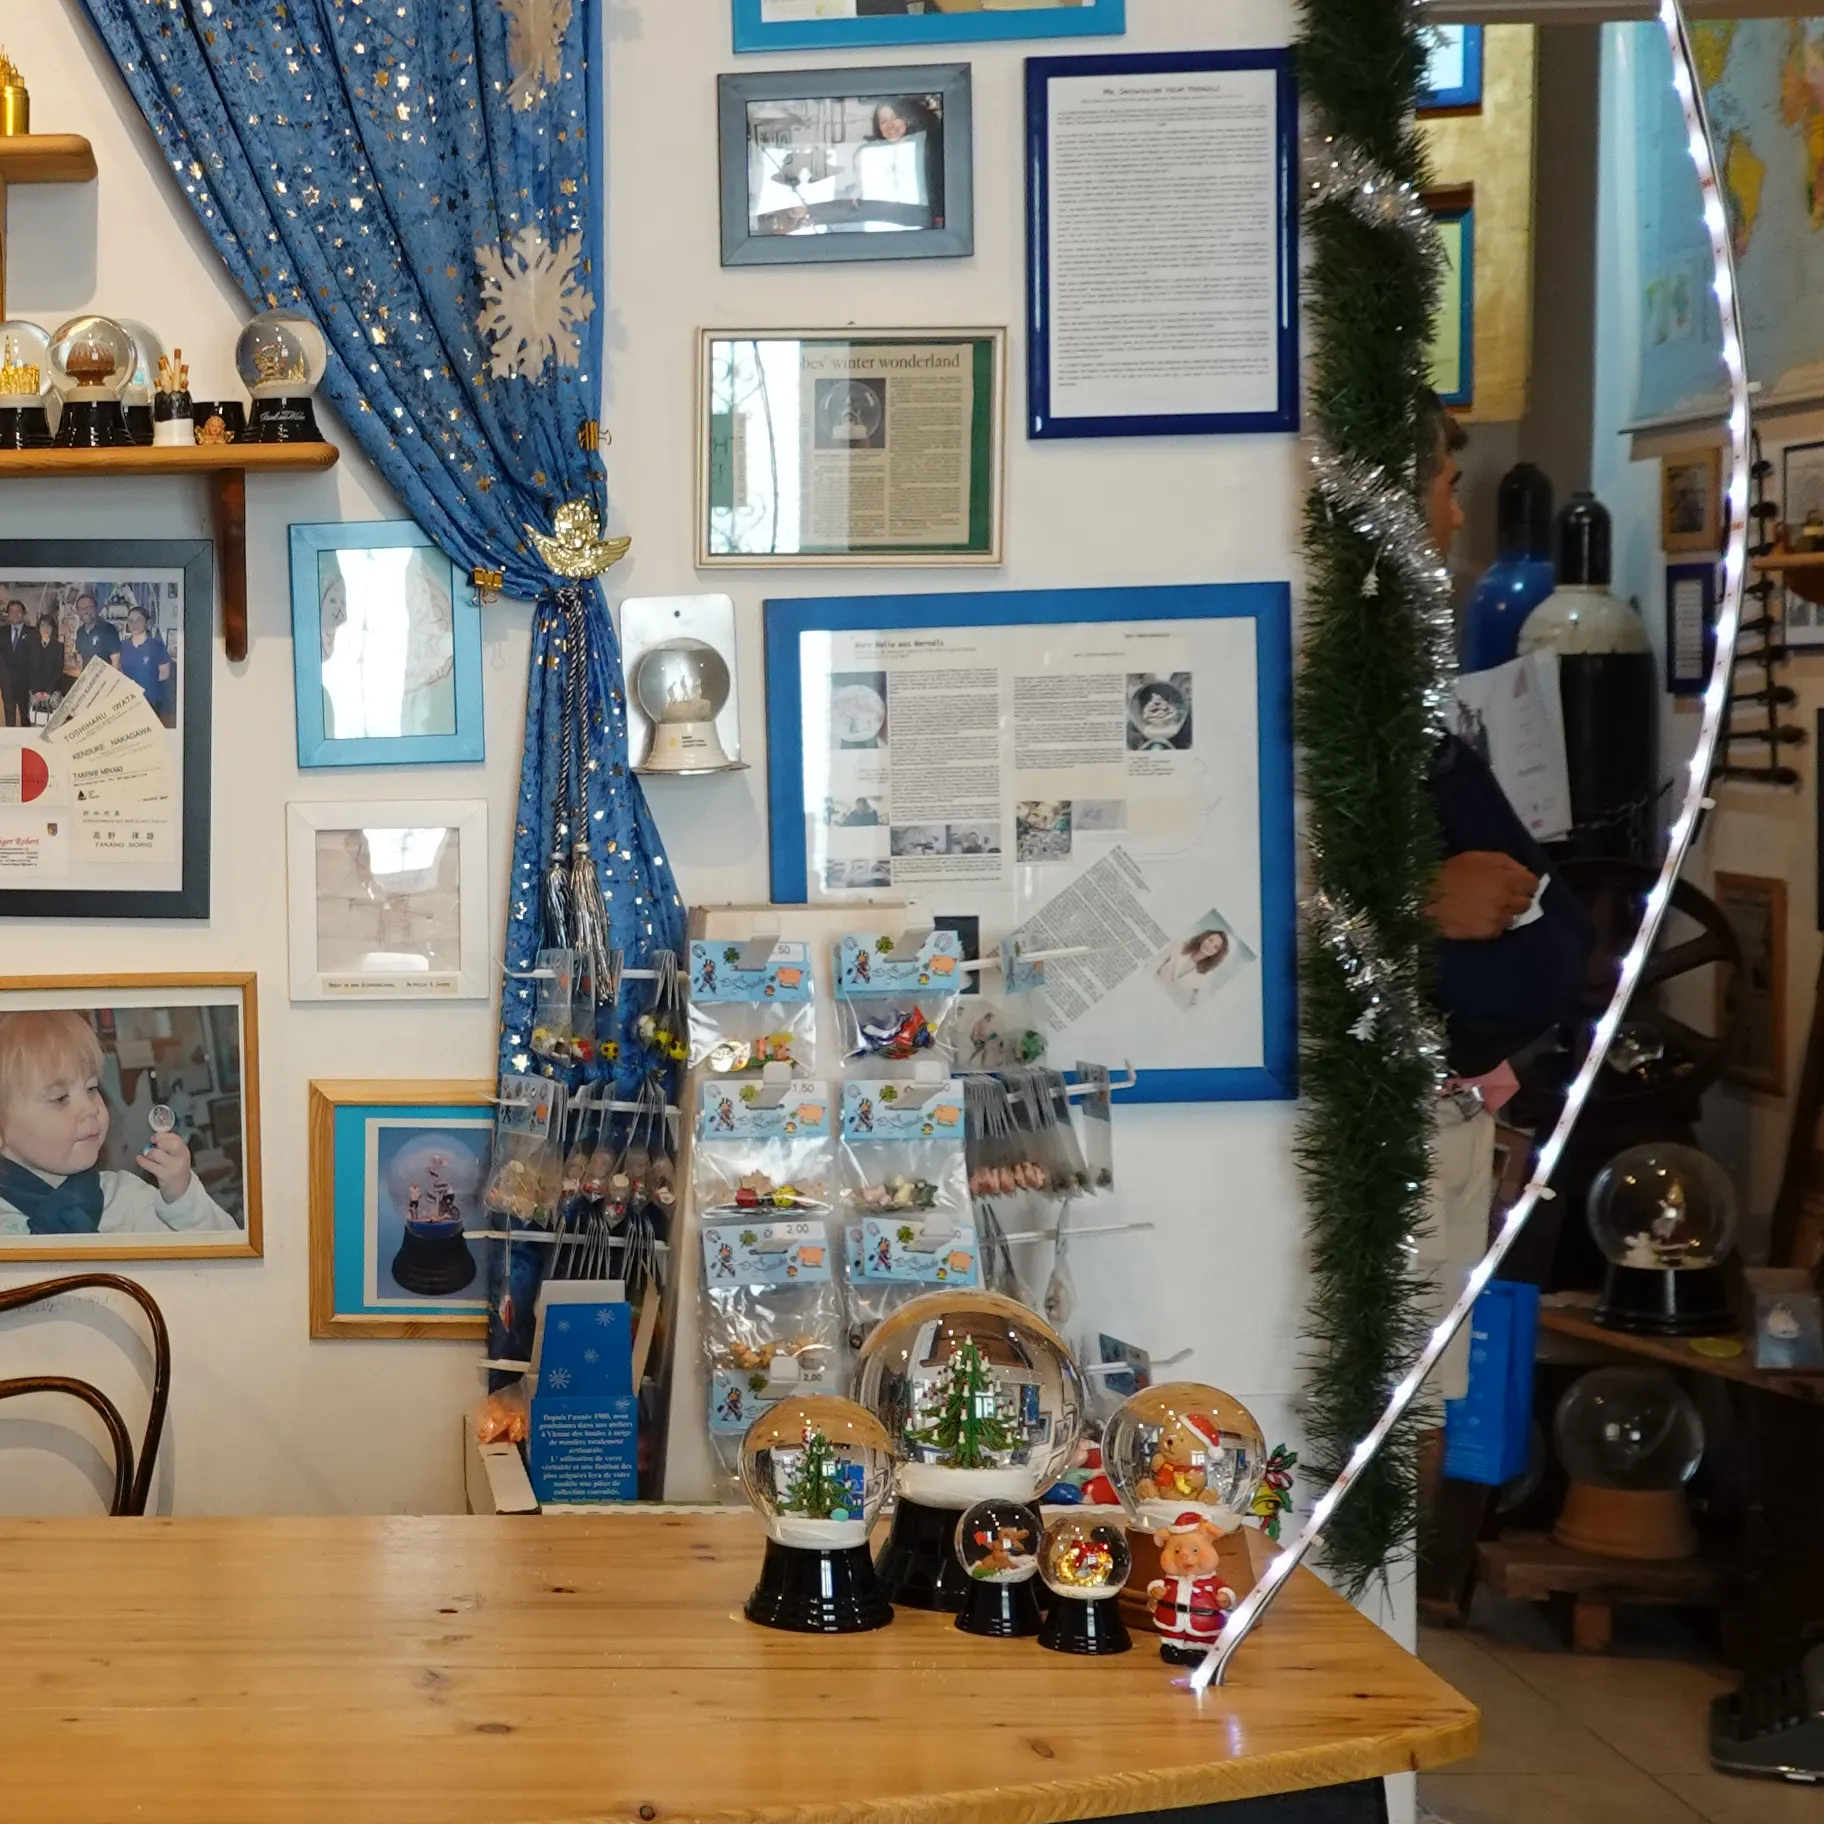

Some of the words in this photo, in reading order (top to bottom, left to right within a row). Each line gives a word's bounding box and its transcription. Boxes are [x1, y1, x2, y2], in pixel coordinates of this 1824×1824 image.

[832, 354, 876, 369] winter
[875, 353, 960, 369] wonderland
[112, 692, 137, 713] IWATA
